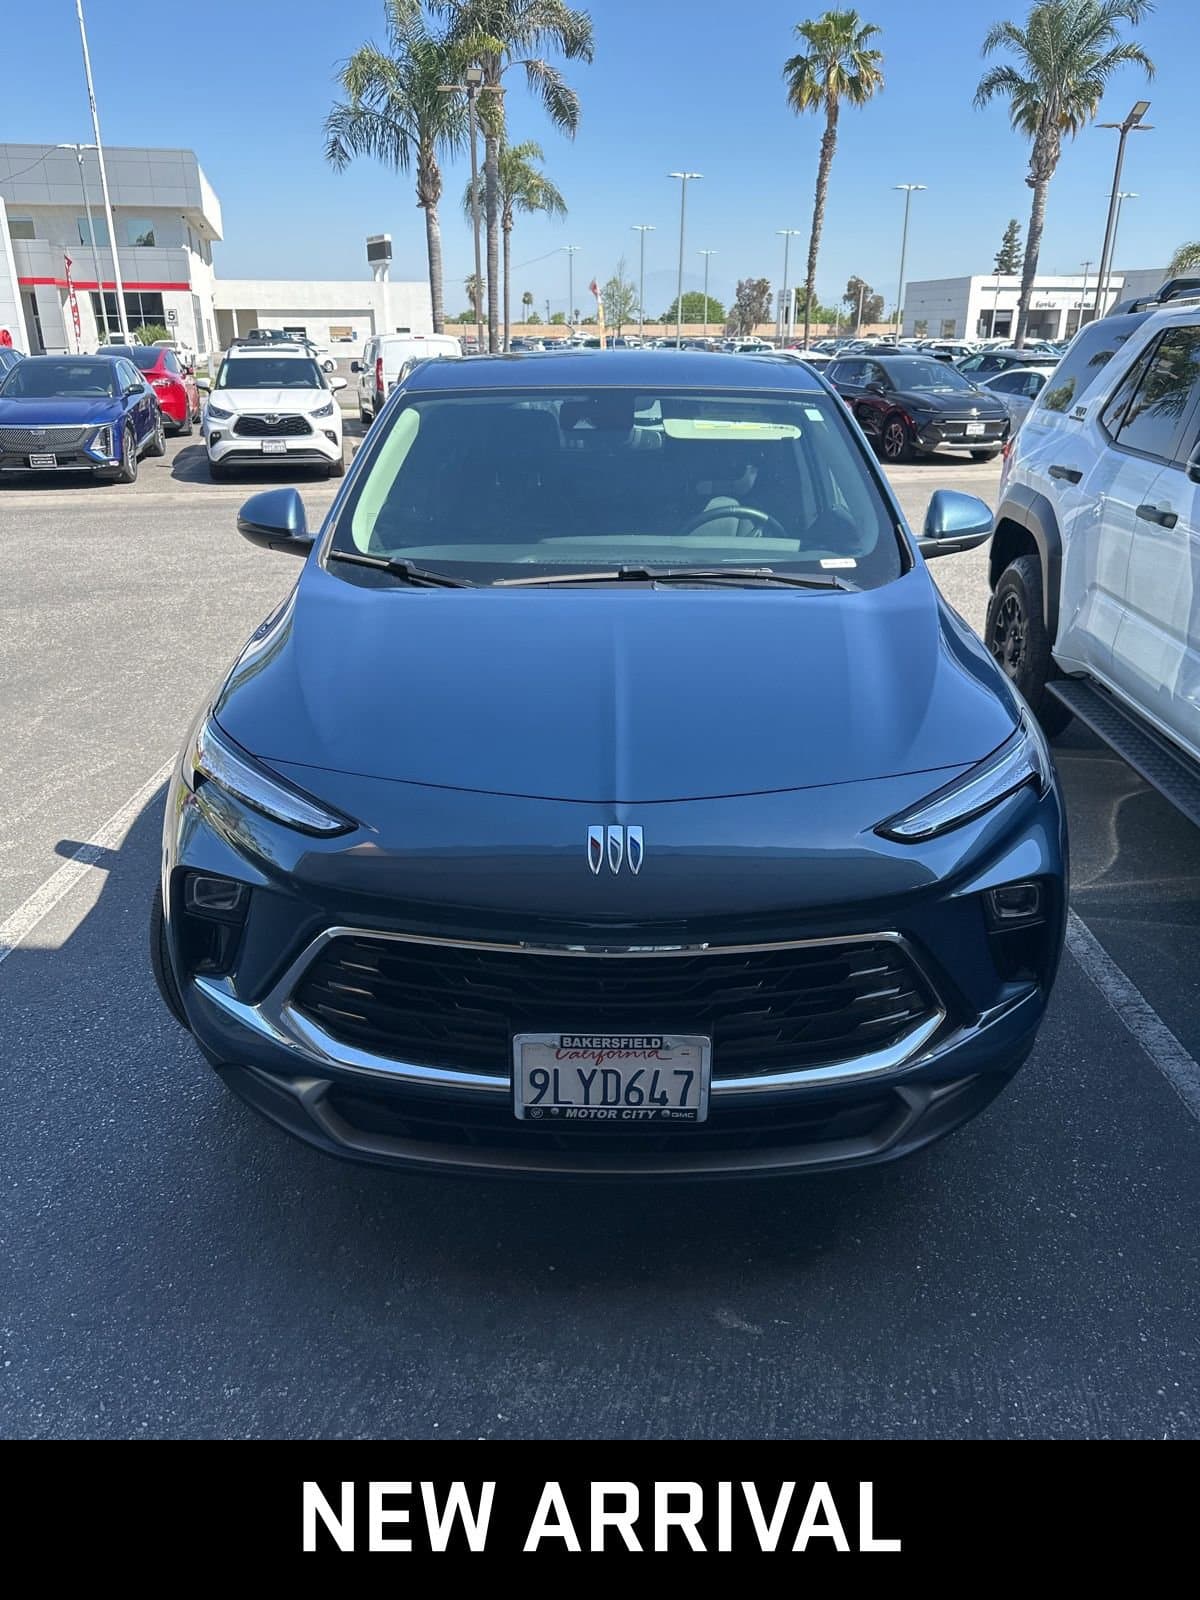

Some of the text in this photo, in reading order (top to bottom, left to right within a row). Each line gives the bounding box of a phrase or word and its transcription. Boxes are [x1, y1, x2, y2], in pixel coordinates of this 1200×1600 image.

[168, 310, 175, 321] 5
[562, 1037, 661, 1049] BAKERSFIELD
[529, 1068, 694, 1106] 9LYD647
[565, 1109, 657, 1120] MOTOR CITY
